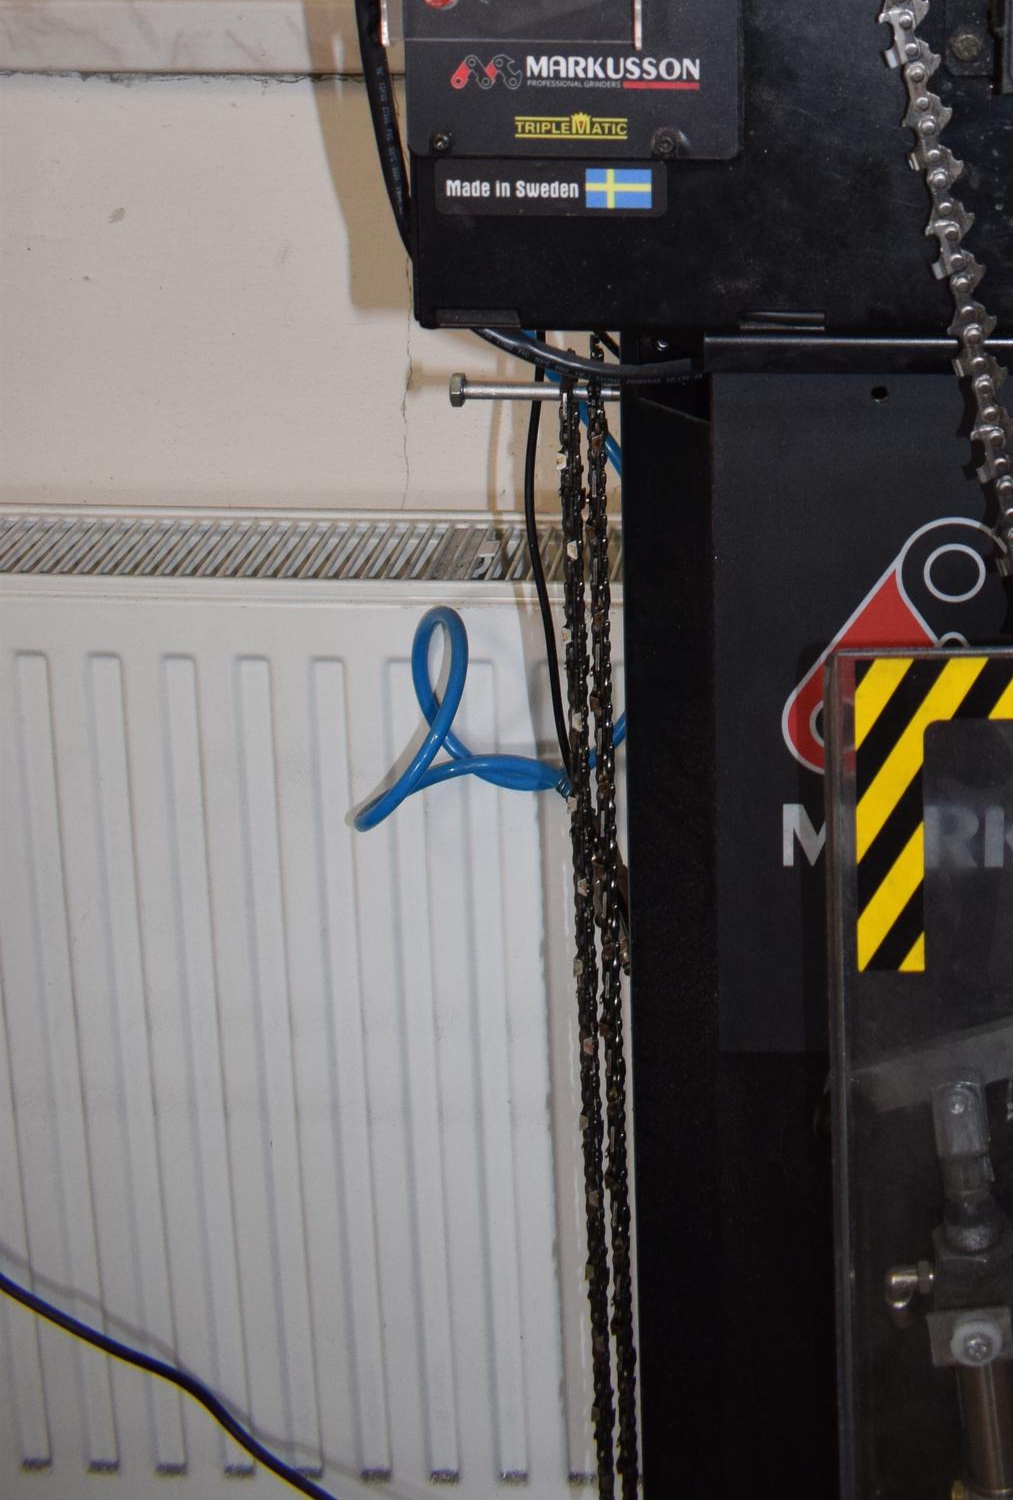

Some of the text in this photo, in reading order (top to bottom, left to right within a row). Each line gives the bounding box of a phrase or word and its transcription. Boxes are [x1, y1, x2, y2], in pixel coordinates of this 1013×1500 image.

[526, 55, 701, 81] MARKUSSON
[527, 79, 622, 90] PROFESSIONAL GRINDERS
[446, 179, 579, 199] Made in Sweden
